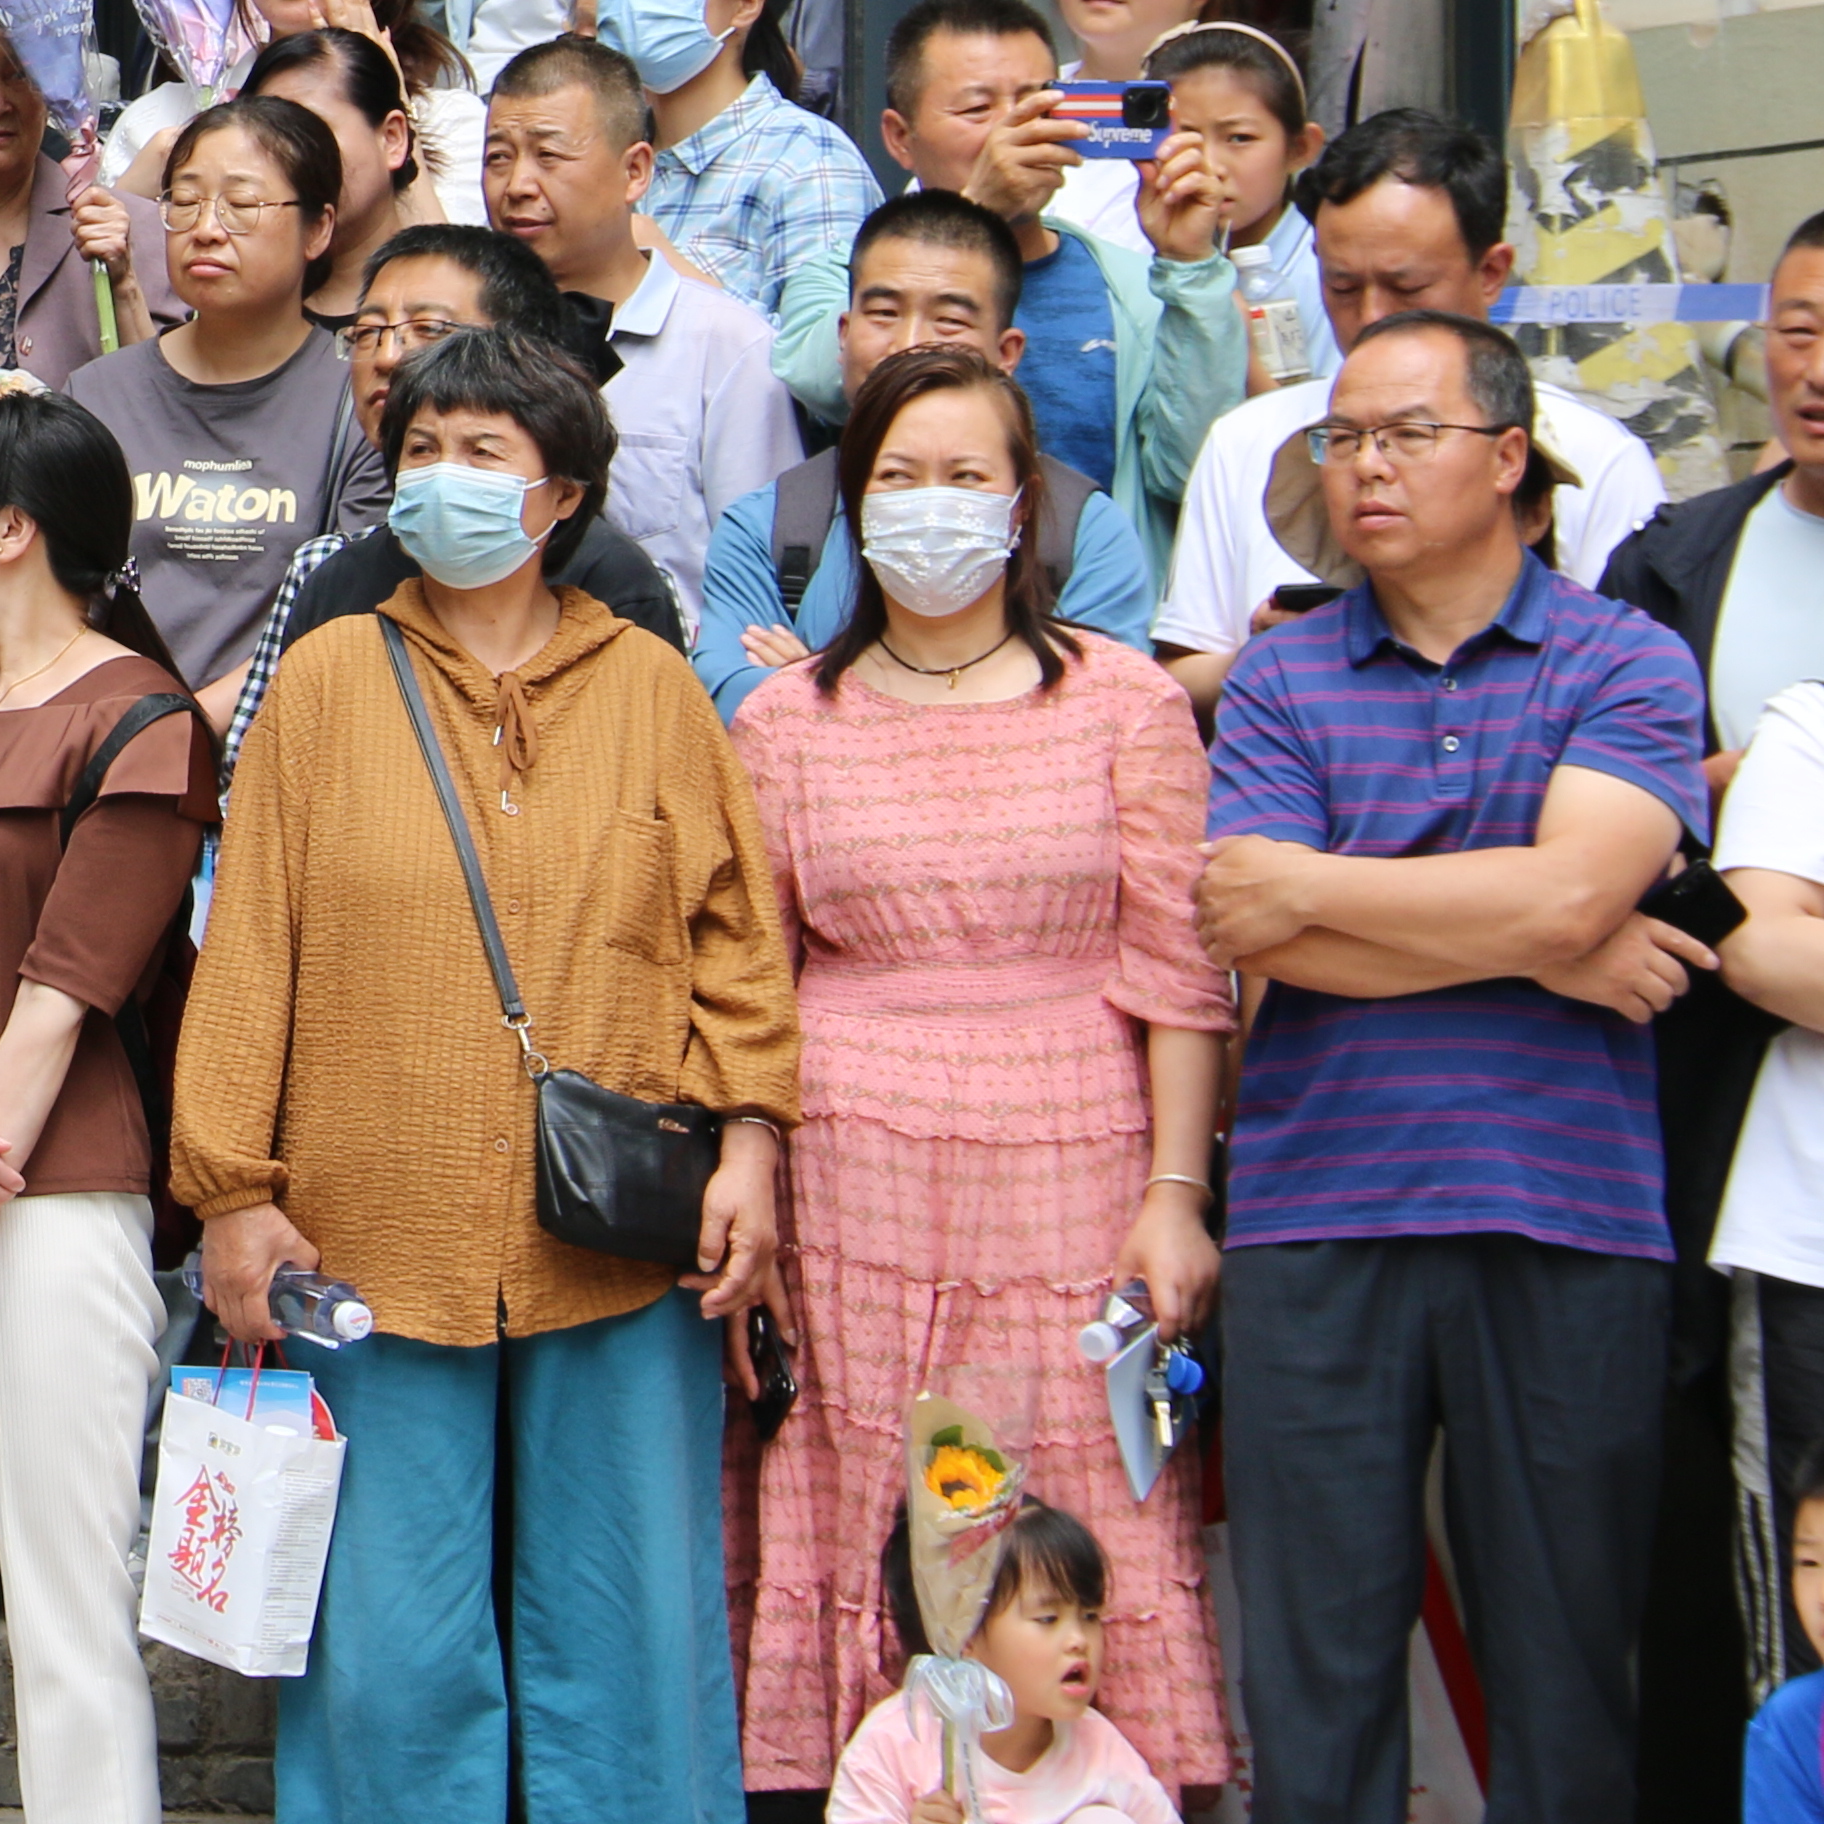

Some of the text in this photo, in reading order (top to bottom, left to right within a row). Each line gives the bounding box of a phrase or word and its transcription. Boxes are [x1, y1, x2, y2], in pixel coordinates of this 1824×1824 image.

[1088, 120, 1153, 149] Supreme
[1551, 288, 1642, 318] POLICE
[132, 472, 297, 523] Waton
